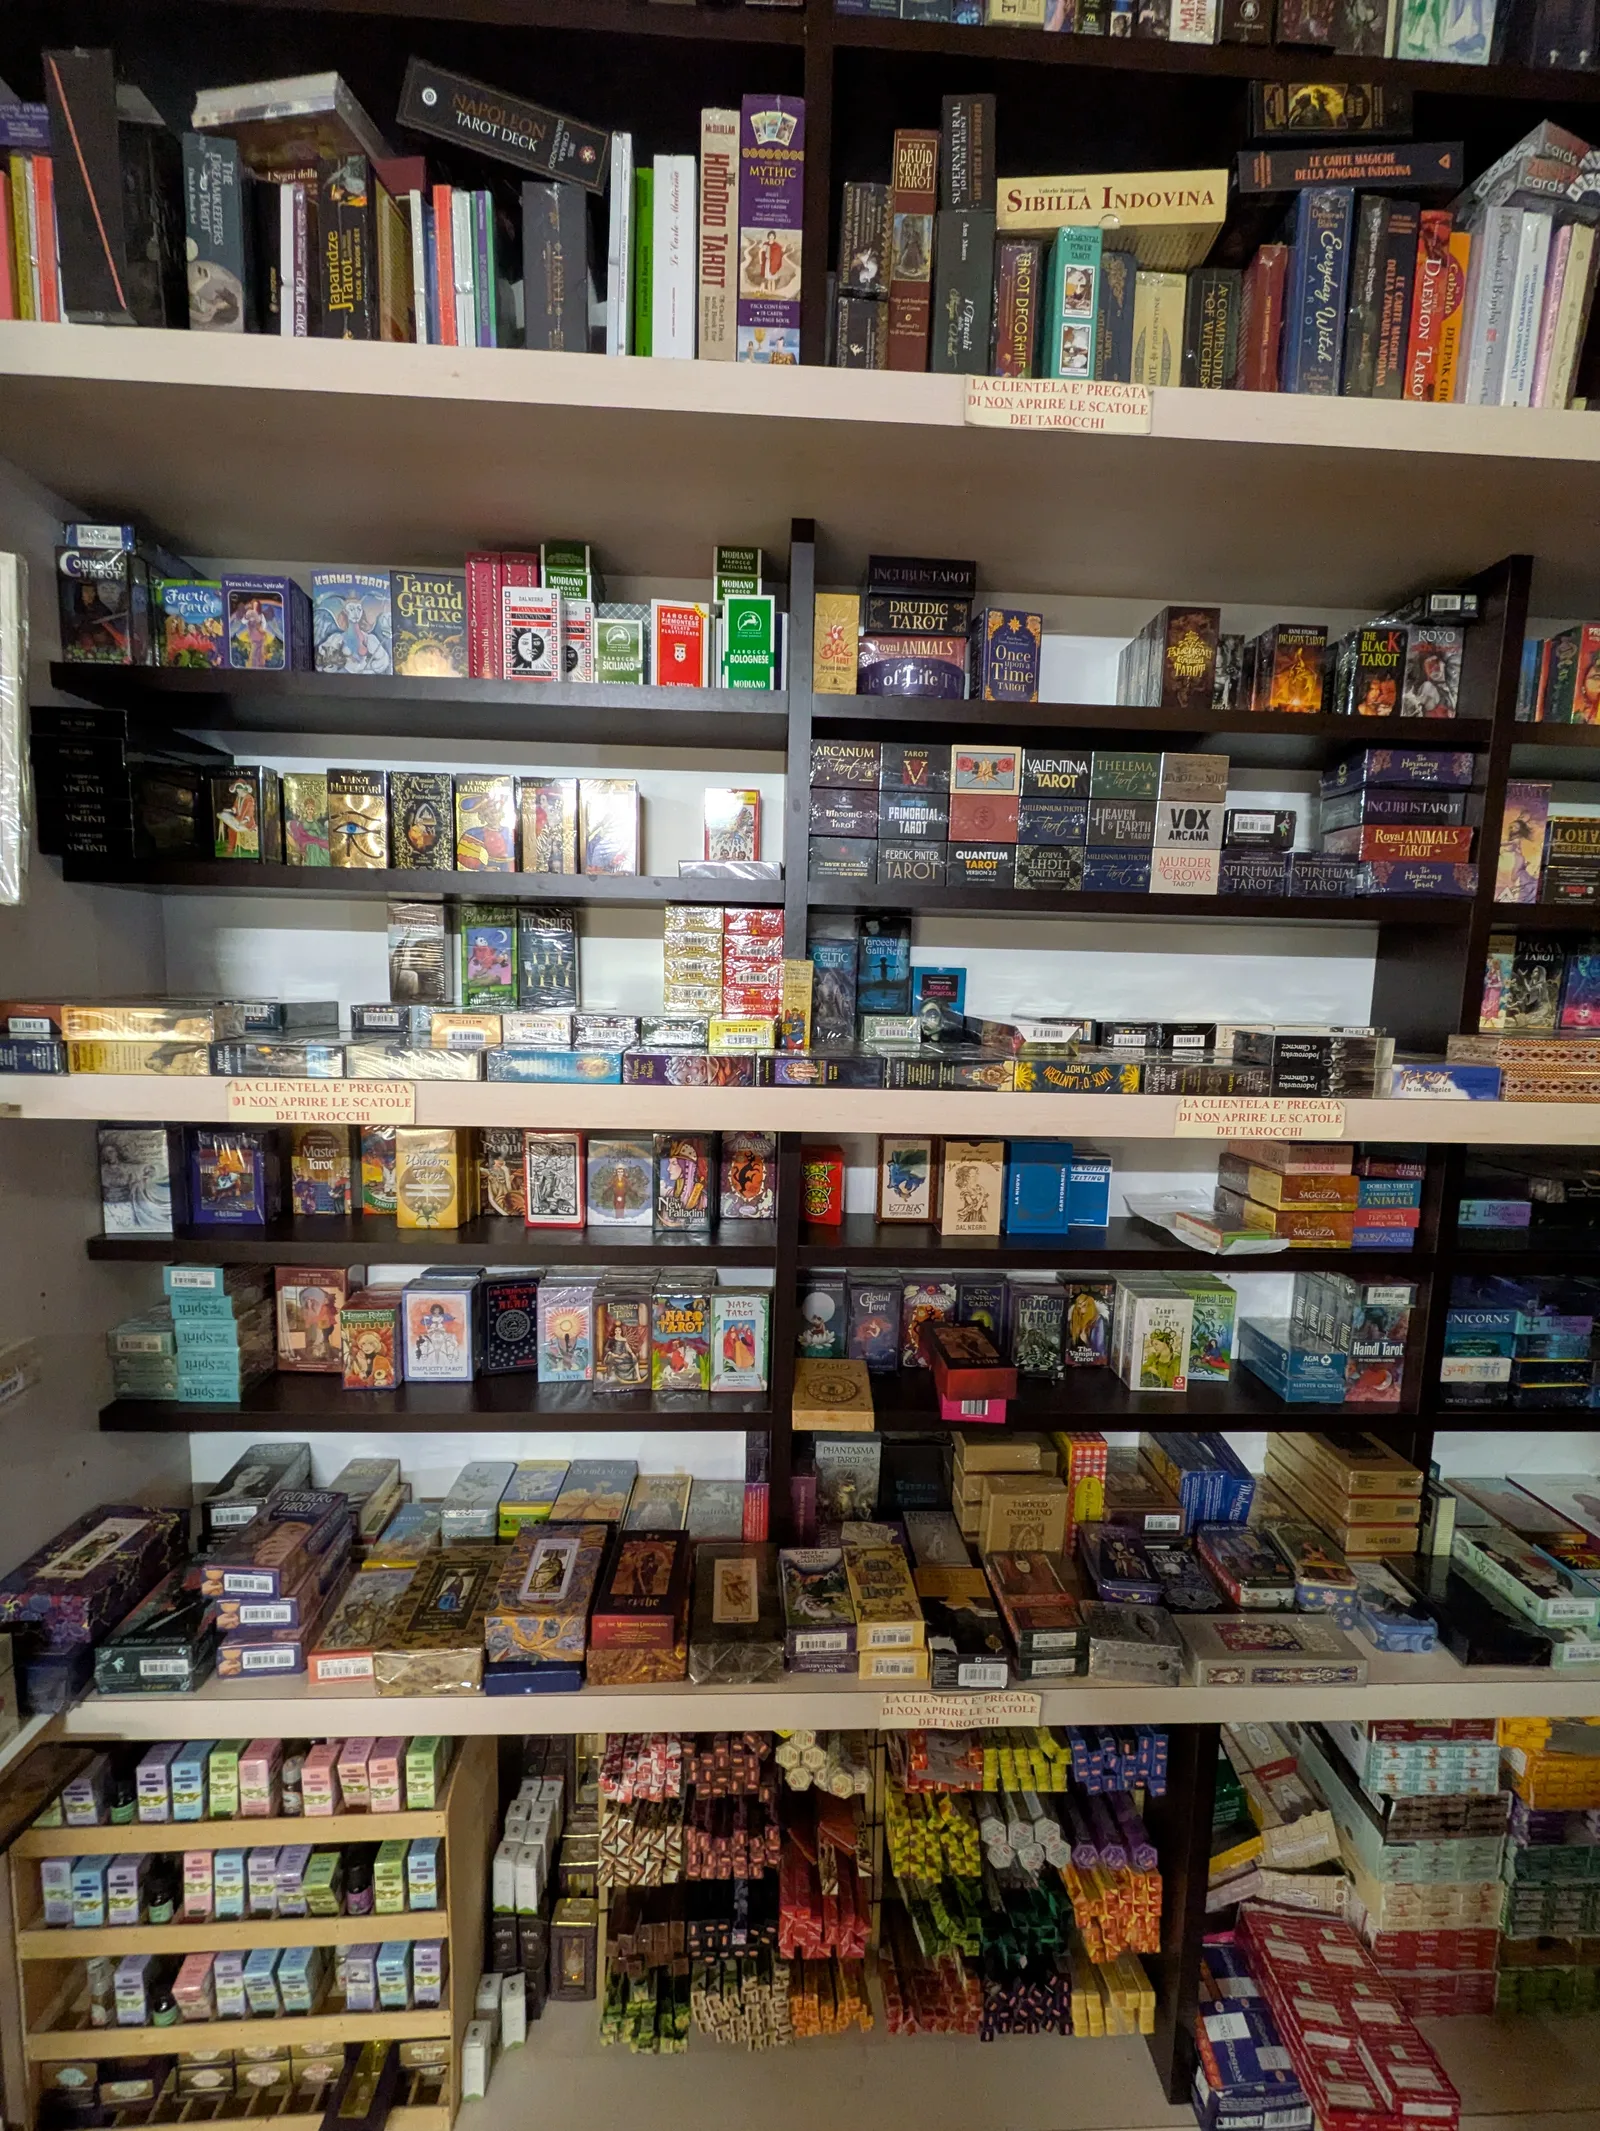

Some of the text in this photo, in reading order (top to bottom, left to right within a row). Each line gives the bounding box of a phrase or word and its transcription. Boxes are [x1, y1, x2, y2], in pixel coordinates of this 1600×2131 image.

[452, 94, 547, 140] NAPOLEON
[456, 110, 539, 153] TAROT DECK
[900, 149, 933, 163] DRUID
[952, 102, 961, 204] SUPERNATURAL
[1544, 140, 1577, 163] cards
[1309, 153, 1396, 167] LE CARTE MAGICHE
[223, 160, 233, 186] THE
[750, 166, 796, 179] MYTHIC
[899, 162, 933, 177] CRAFT
[1295, 165, 1411, 180] DELLA ZINGARA INDOVINA
[760, 177, 786, 186] TAROT
[899, 175, 932, 189] TAROT
[1524, 175, 1564, 194] cards
[211, 152, 224, 245] DREAMKEEPERS
[1006, 186, 1215, 213] SIBILLA INDOVINA
[702, 153, 730, 288] HOODOO TAROT
[328, 230, 338, 312] Japaridze
[1444, 263, 1458, 315] Cabala
[1315, 231, 1341, 363] Everyday Witch
[1013, 251, 1032, 369] TAROT DECORATIF
[972, 379, 1146, 399] LA CLIENTELA E' PREGATA
[968, 395, 1148, 416] DI NON APRIRE LE SCATOLE
[1010, 414, 1105, 429] DEI TAROCCHI
[722, 551, 753, 559] MODIANO
[396, 574, 454, 596] Tarot
[550, 576, 583, 586] MODIANO
[722, 580, 753, 589] MODIANO
[397, 592, 463, 617] Grand
[889, 601, 948, 615] DRUIDIC
[415, 608, 461, 627] Luxe
[661, 612, 699, 620] TAROCCO
[661, 619, 699, 627] PIEMONTESE
[889, 615, 948, 631] TAROT
[1362, 631, 1400, 652] BLACK
[1363, 631, 1376, 641] THE
[1418, 629, 1455, 643] ROYO
[873, 641, 953, 656] Royal ANIMALS
[995, 646, 1031, 662] Once
[730, 655, 769, 664] BOLOGNESE
[1360, 653, 1400, 667] TAROT
[602, 662, 635, 671] SICILIANO
[991, 662, 1034, 683] Time
[733, 680, 765, 688] MODIANO
[998, 683, 1026, 692] TAROT
[815, 746, 874, 758] ARCANUM
[1027, 759, 1088, 774] VALENTINA
[1097, 760, 1153, 772] THELEMA
[1036, 774, 1078, 788] TAROT
[888, 806, 939, 821] PRIMORDIAL
[1022, 804, 1085, 813] MILLENNIUM THOTH
[1170, 808, 1211, 829] VOX
[899, 821, 928, 834] TAROT
[1168, 830, 1209, 841] ARCANA
[885, 850, 939, 860] FERENC PINTER
[956, 851, 1008, 860] QUANTUM
[1398, 844, 1432, 857] TAROT
[966, 860, 997, 869] TAROT
[1028, 859, 1070, 870] LIGHT
[1160, 857, 1211, 867] MURDER
[886, 861, 938, 880] TAROT
[1163, 870, 1211, 881] CROWS
[1232, 878, 1274, 891] TAROT
[1303, 879, 1346, 891] TAROT
[521, 917, 572, 933] TV SERIES
[862, 937, 897, 947] Tarocchi
[813, 952, 848, 962] CELTIC
[1524, 954, 1555, 962] TAROT
[1281, 1050, 1320, 1061] Jodorowsky
[234, 1083, 409, 1094] LA CLIENTELA E' PREGATA
[1279, 1081, 1318, 1091] Jodorowsky
[233, 1096, 411, 1107] DI NON APRIRE LE SCATOLE
[1183, 1099, 1341, 1109] LA CLIENTELA E' PREGATA
[276, 1111, 370, 1121] DEI TAROCCHI
[1179, 1112, 1342, 1123] DI NON APRIRE LE SCATOLE
[1217, 1127, 1302, 1136] DEI TAROCCHI
[302, 1146, 339, 1157] Master
[307, 1157, 333, 1170] Tarot
[1299, 1191, 1340, 1199] SAGGEZZA
[1366, 1197, 1413, 1205] ANIMALI
[668, 1208, 705, 1219] Palladini
[1293, 1228, 1335, 1237] SAGGEZZA
[607, 1302, 638, 1312] Fenestra
[727, 1299, 753, 1309] NAPO
[1020, 1300, 1063, 1311] DRAGON
[665, 1310, 704, 1322] NAPO
[725, 1308, 754, 1317] TAROT
[1019, 1311, 1063, 1324] TAROT
[1353, 1342, 1404, 1356] Haindl Tarot
[1303, 1355, 1318, 1363] AGM
[823, 1446, 874, 1455] PHANTASMA
[836, 1456, 860, 1464] TAROT
[886, 1695, 902, 1703] LA
[903, 1695, 968, 1705] CLIENTELA
[984, 1695, 1035, 1703] PREGATA
[882, 1706, 1037, 1716] DI NON APRIRE LE SCATOLE
[918, 1717, 999, 1727] DEI TAROCCHI
